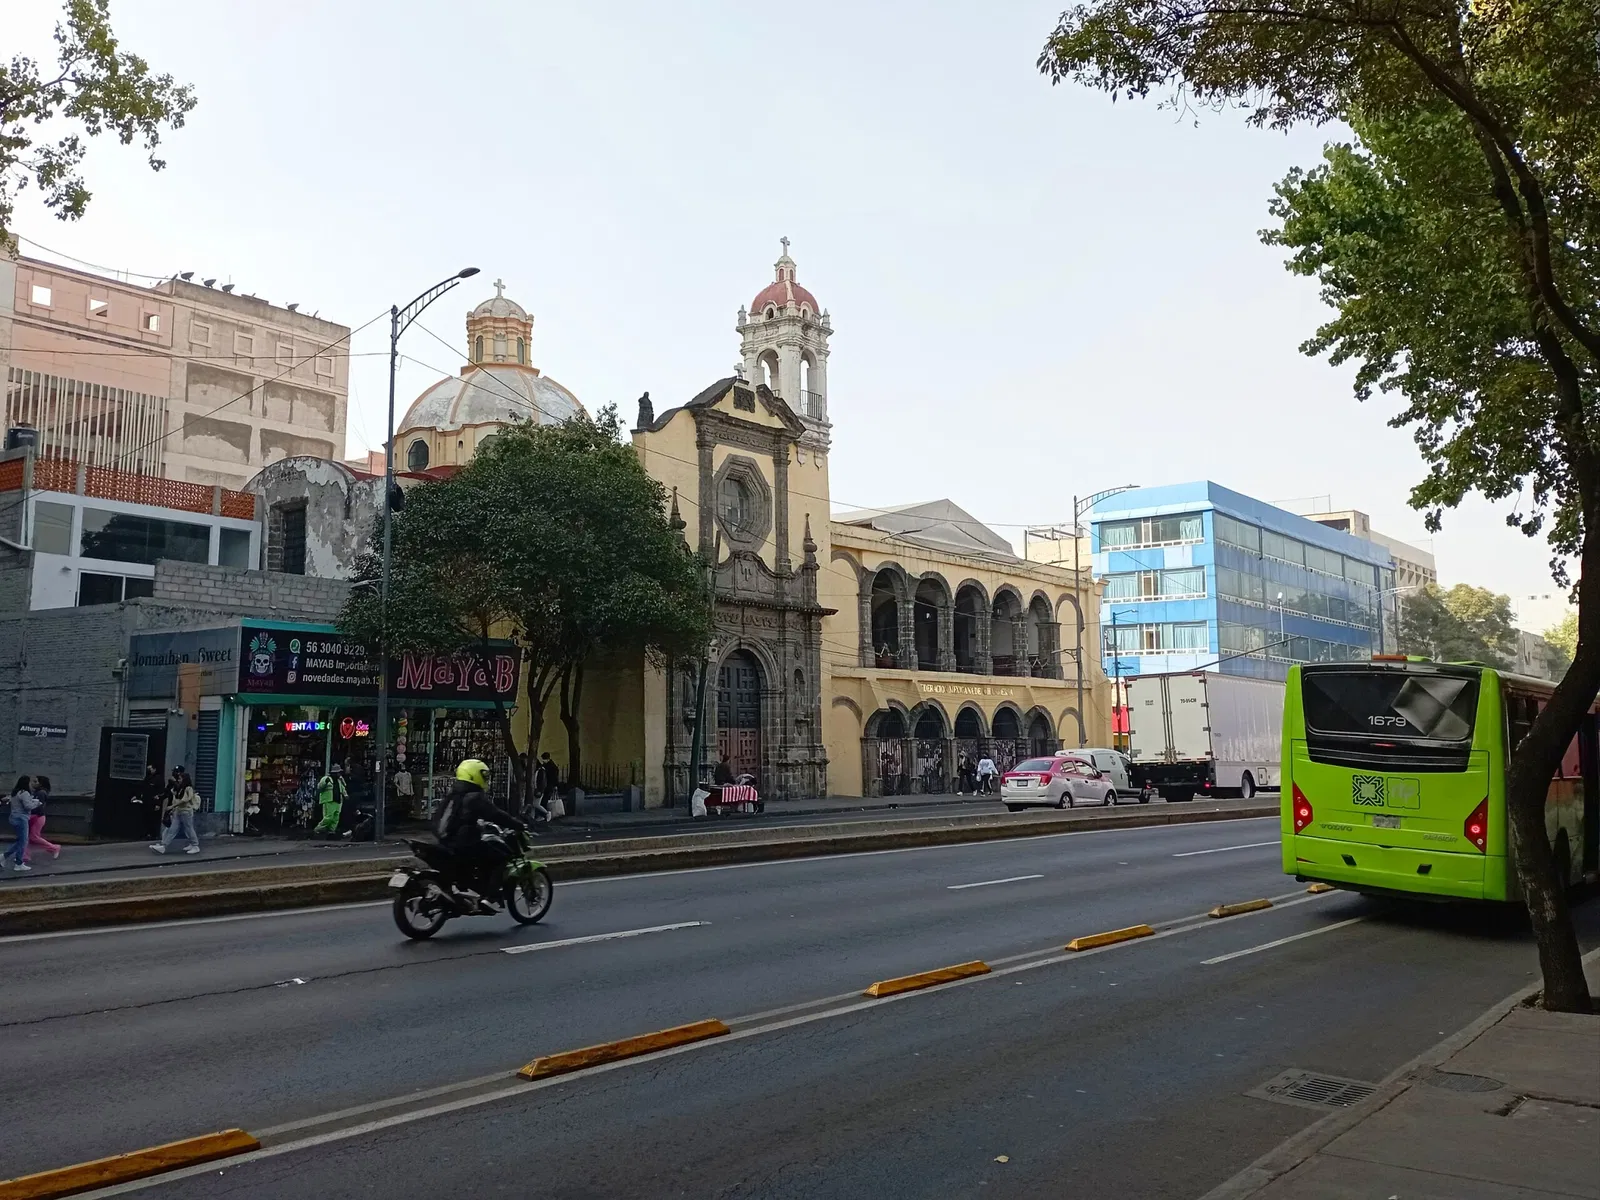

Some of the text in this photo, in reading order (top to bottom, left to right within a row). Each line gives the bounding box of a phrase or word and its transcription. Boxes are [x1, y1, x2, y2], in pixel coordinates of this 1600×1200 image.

[306, 641, 365, 656] 56 3040 9229
[132, 646, 232, 667] Jonnathan Sweet
[305, 657, 334, 669] MAYAB
[285, 721, 312, 732] VENTA
[314, 721, 325, 730] DE
[355, 719, 369, 730] Sex
[1368, 715, 1406, 727] 1679
